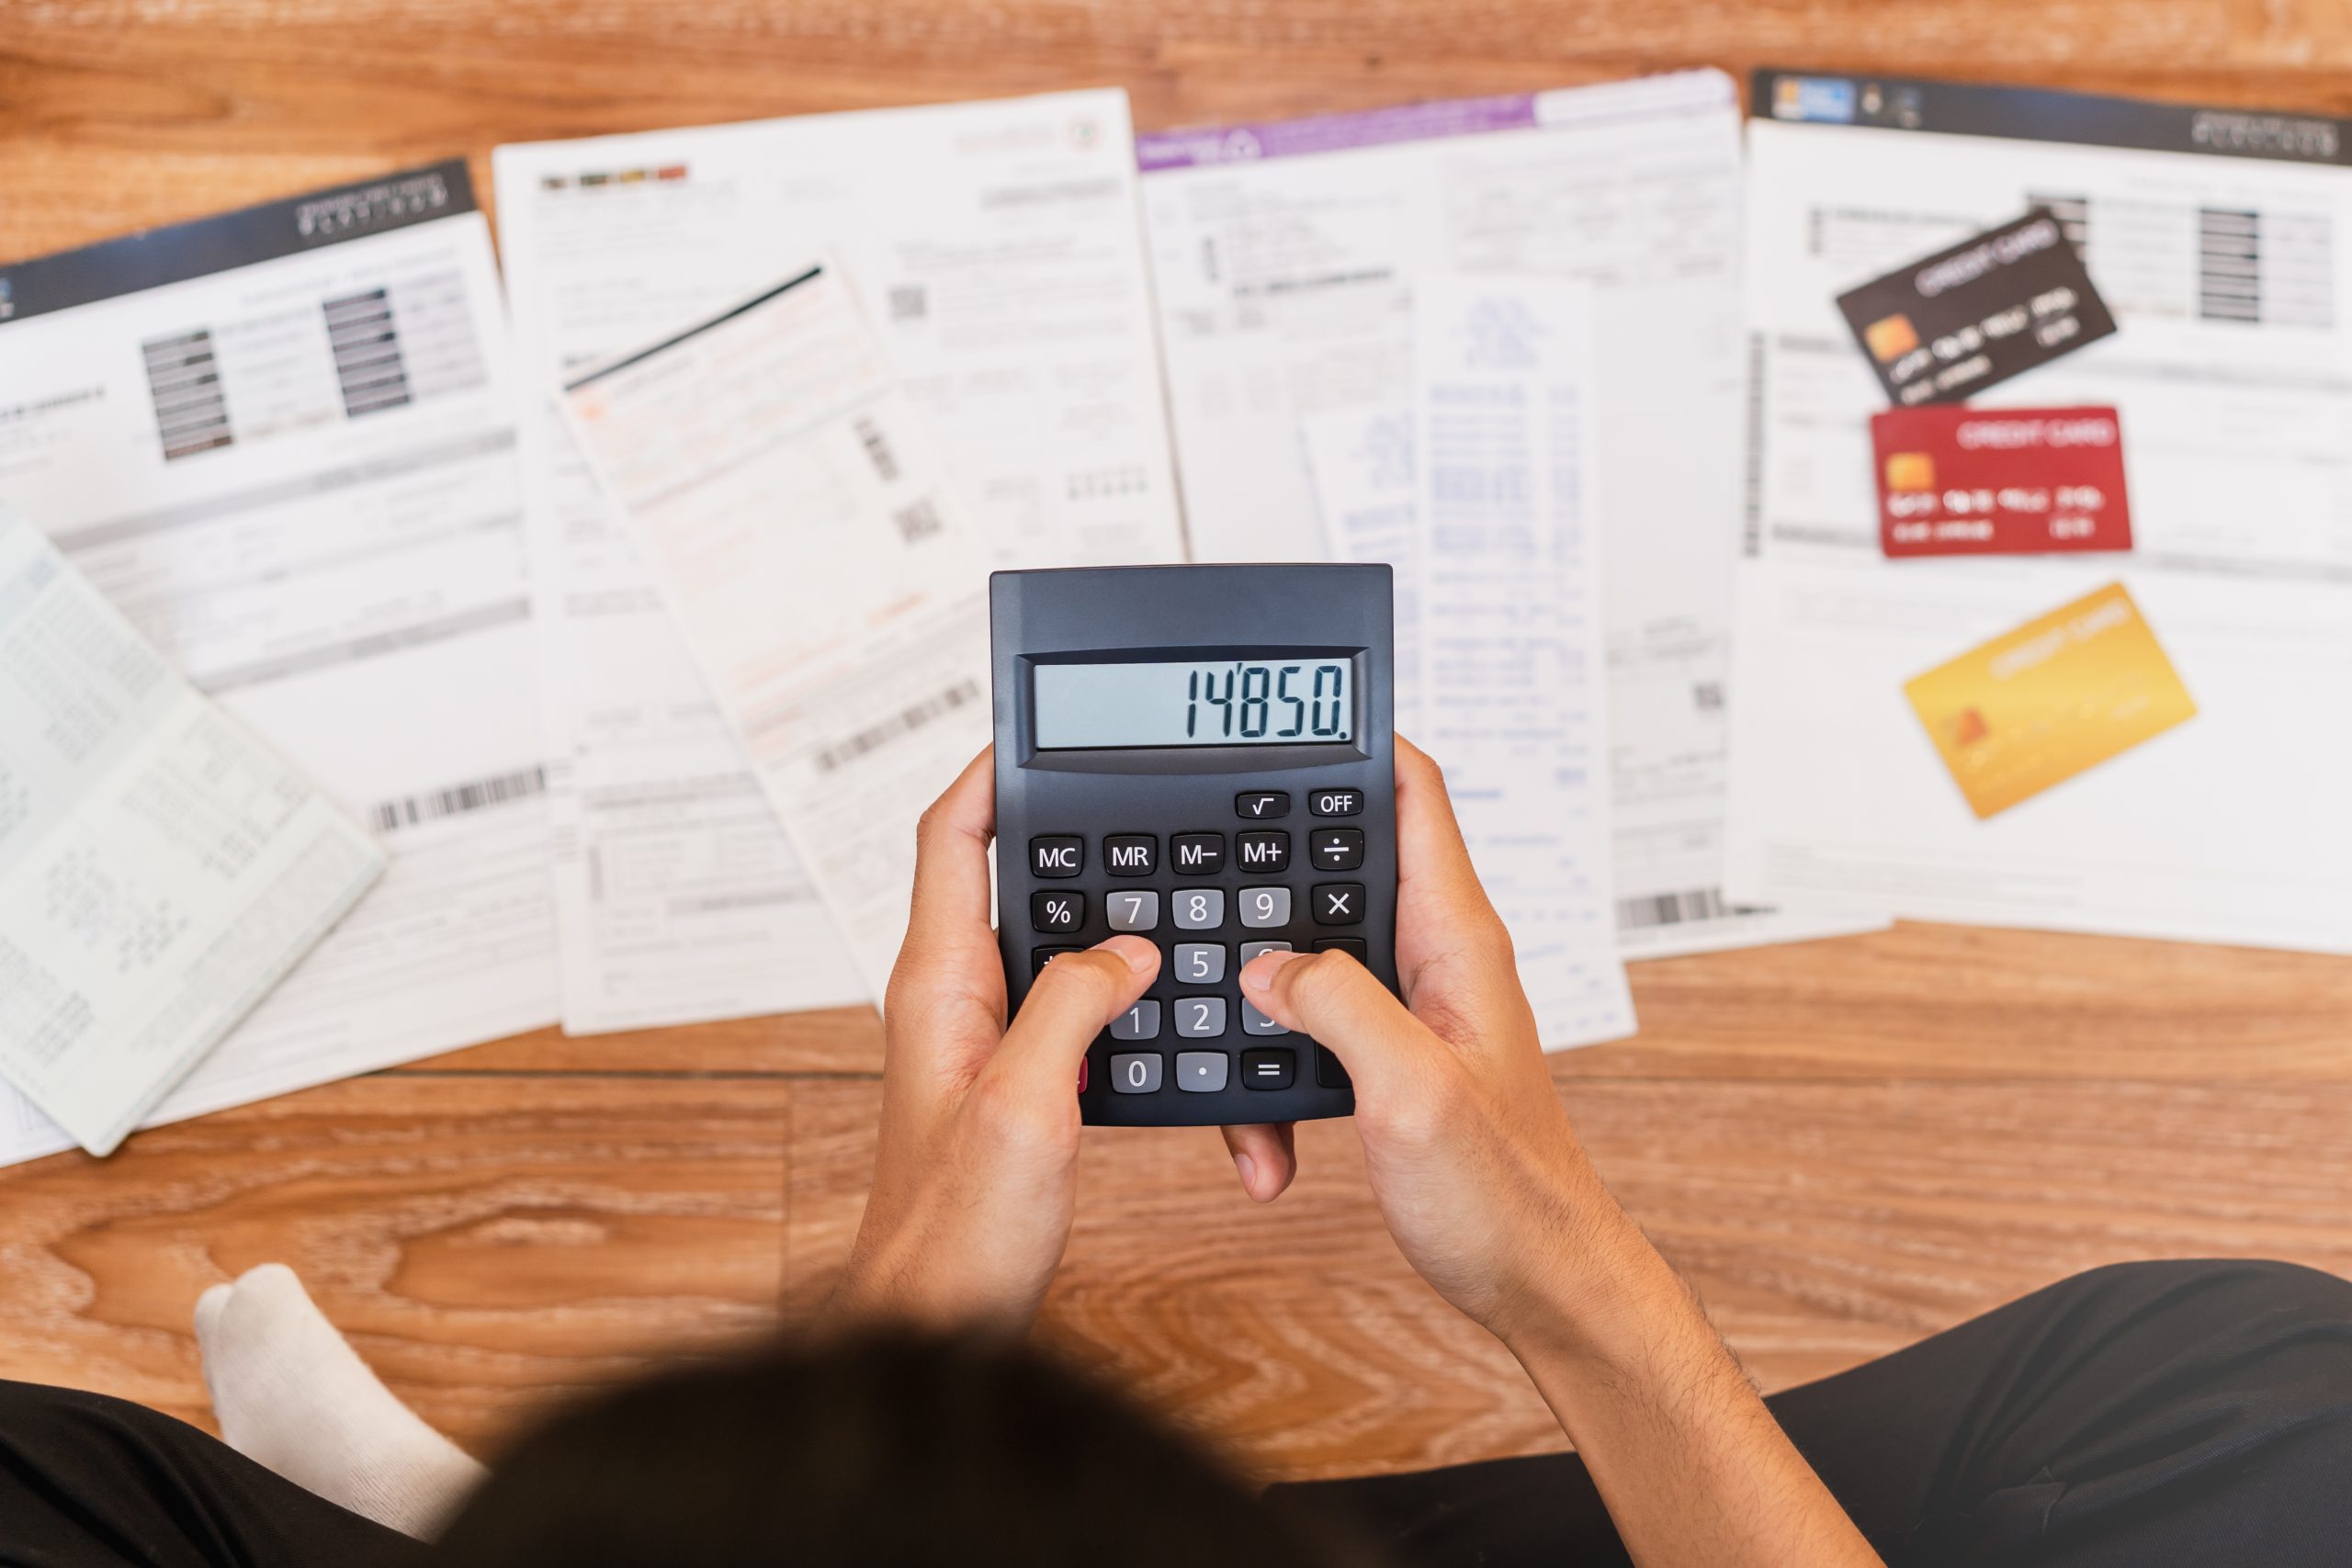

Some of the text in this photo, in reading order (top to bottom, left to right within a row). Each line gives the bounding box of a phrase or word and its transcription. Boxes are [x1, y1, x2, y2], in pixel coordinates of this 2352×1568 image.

[1320, 795, 1352, 813] OFF
[1039, 847, 1076, 868] MC
[1113, 846, 1148, 866] MR
[1244, 842, 1282, 863] M+
[1046, 900, 1071, 924] %
[1125, 897, 1142, 924] 7
[1189, 895, 1207, 922] 8
[1256, 893, 1273, 920] 9
[1193, 951, 1209, 977] 5
[1129, 1007, 1140, 1033] 1
[1193, 1004, 1210, 1031] 2
[1128, 1060, 1147, 1087] 0
